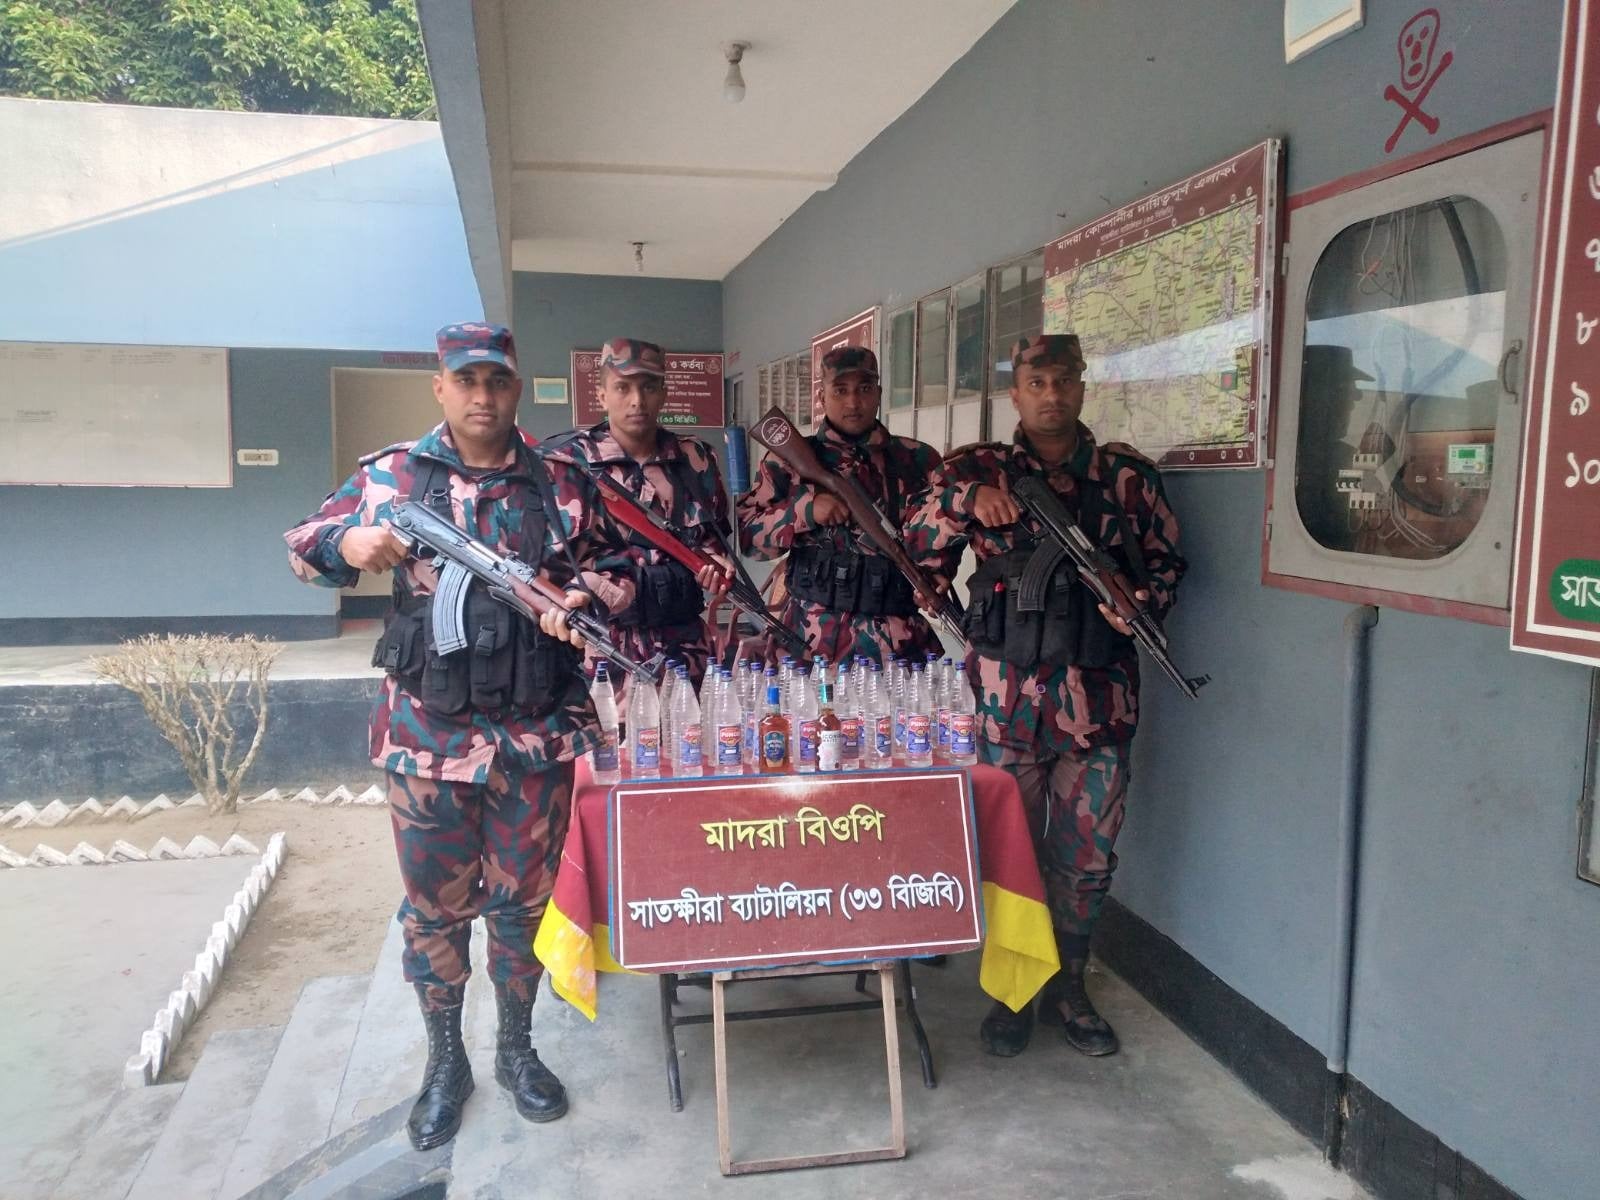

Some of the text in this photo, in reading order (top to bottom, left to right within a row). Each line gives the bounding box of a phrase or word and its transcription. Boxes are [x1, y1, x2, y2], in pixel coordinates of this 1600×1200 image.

[1194, 163, 1237, 189] এলাকা
[1570, 381, 1590, 416] ৯
[700, 803, 885, 852] মাদরা বিওপি
[628, 871, 965, 928] সাতক্ষীরা ব্যাটালিয়ন (৩৩ বিজিবি)
